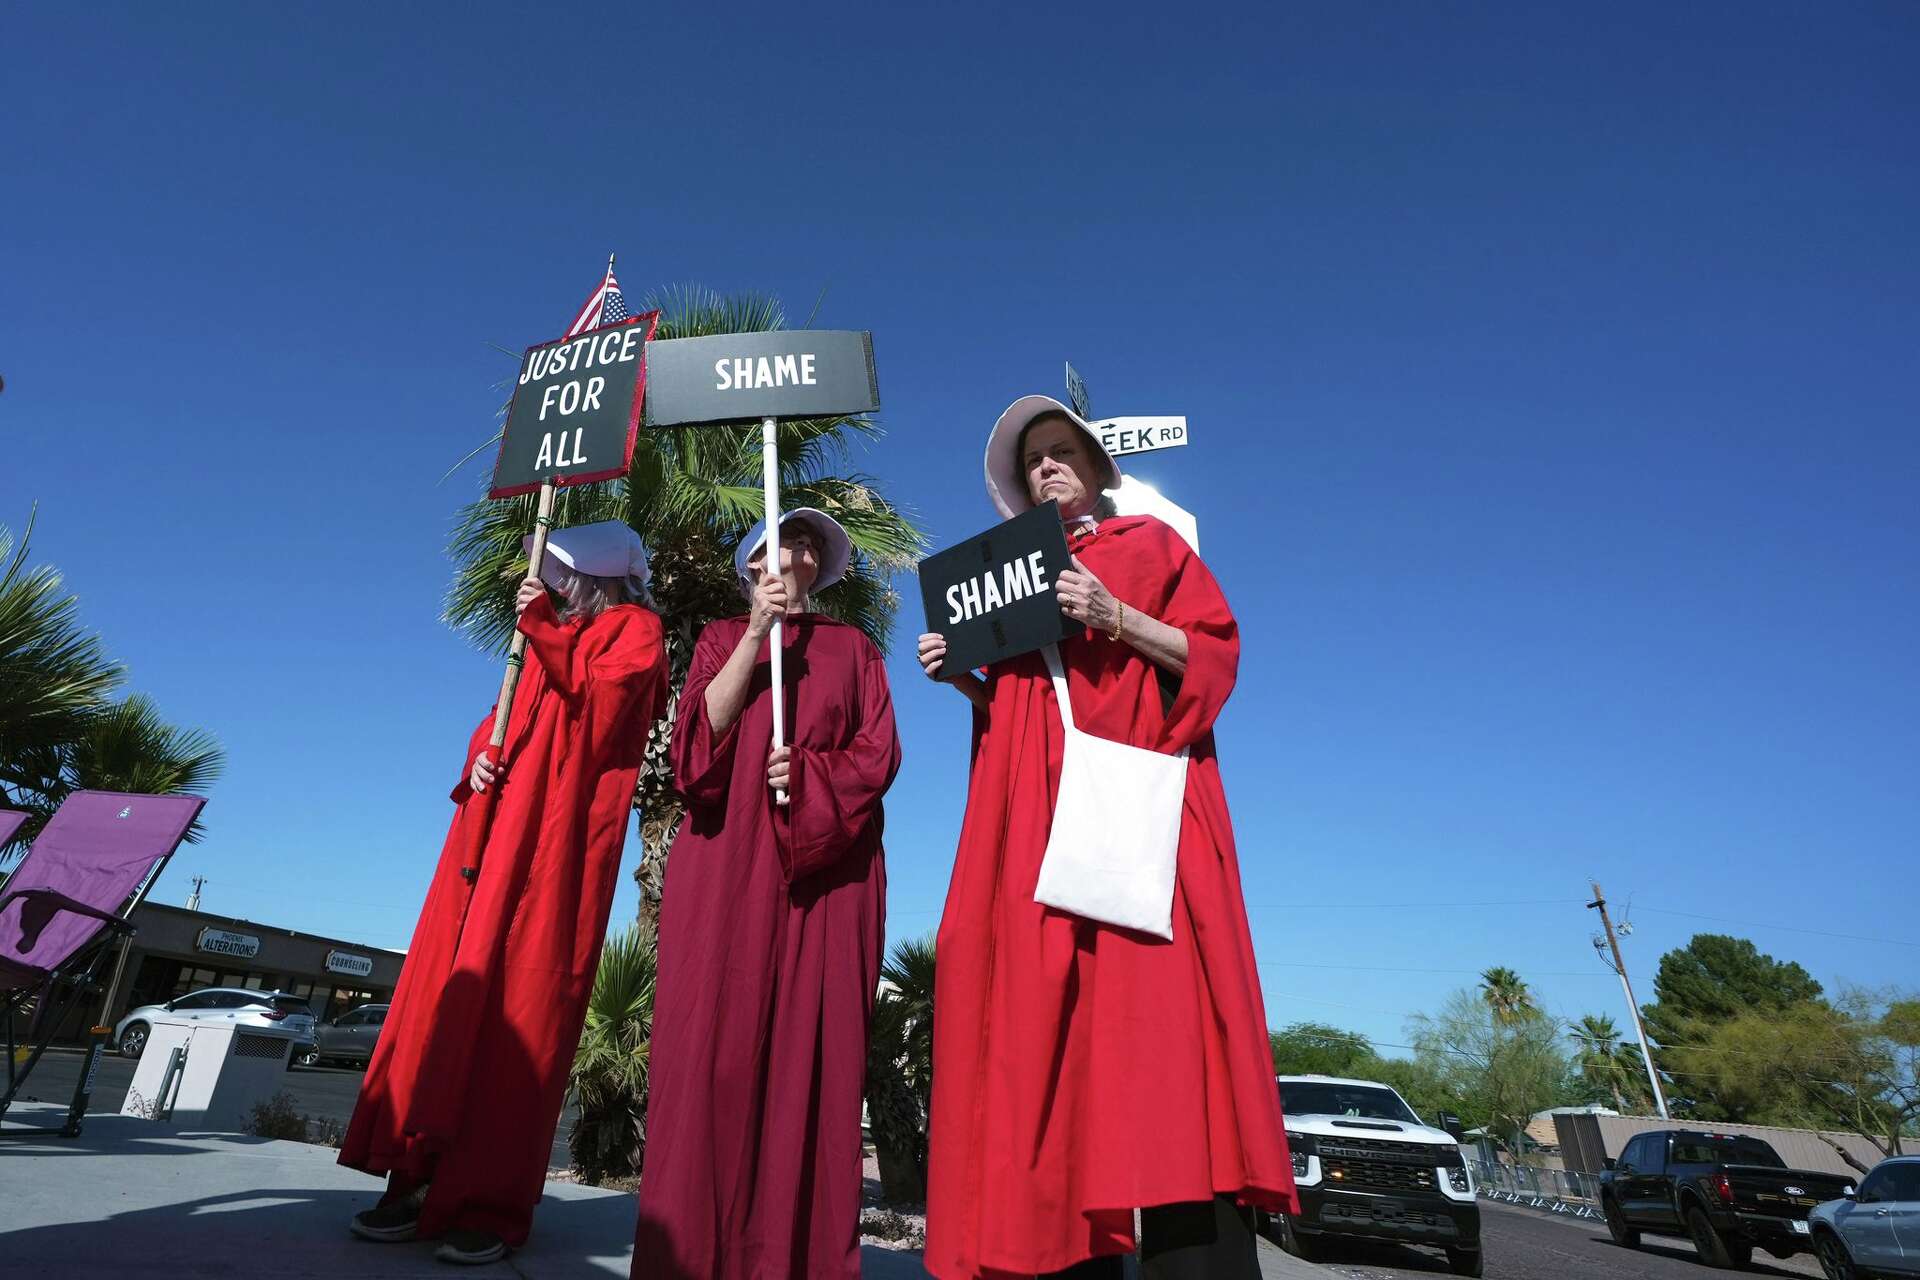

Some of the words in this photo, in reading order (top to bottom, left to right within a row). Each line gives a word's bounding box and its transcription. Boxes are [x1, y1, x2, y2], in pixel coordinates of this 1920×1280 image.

[519, 327, 642, 385] JUSTICE
[714, 353, 817, 390] SHAME
[539, 376, 605, 421] FOR
[534, 427, 588, 471] ALL
[1102, 427, 1155, 453] EEK
[1160, 426, 1184, 441] RD
[946, 550, 1050, 625] SHAME
[204, 938, 256, 956] ALTERATIONS
[331, 956, 370, 971] COUNSELING
[1756, 1194, 1819, 1207] F-15
